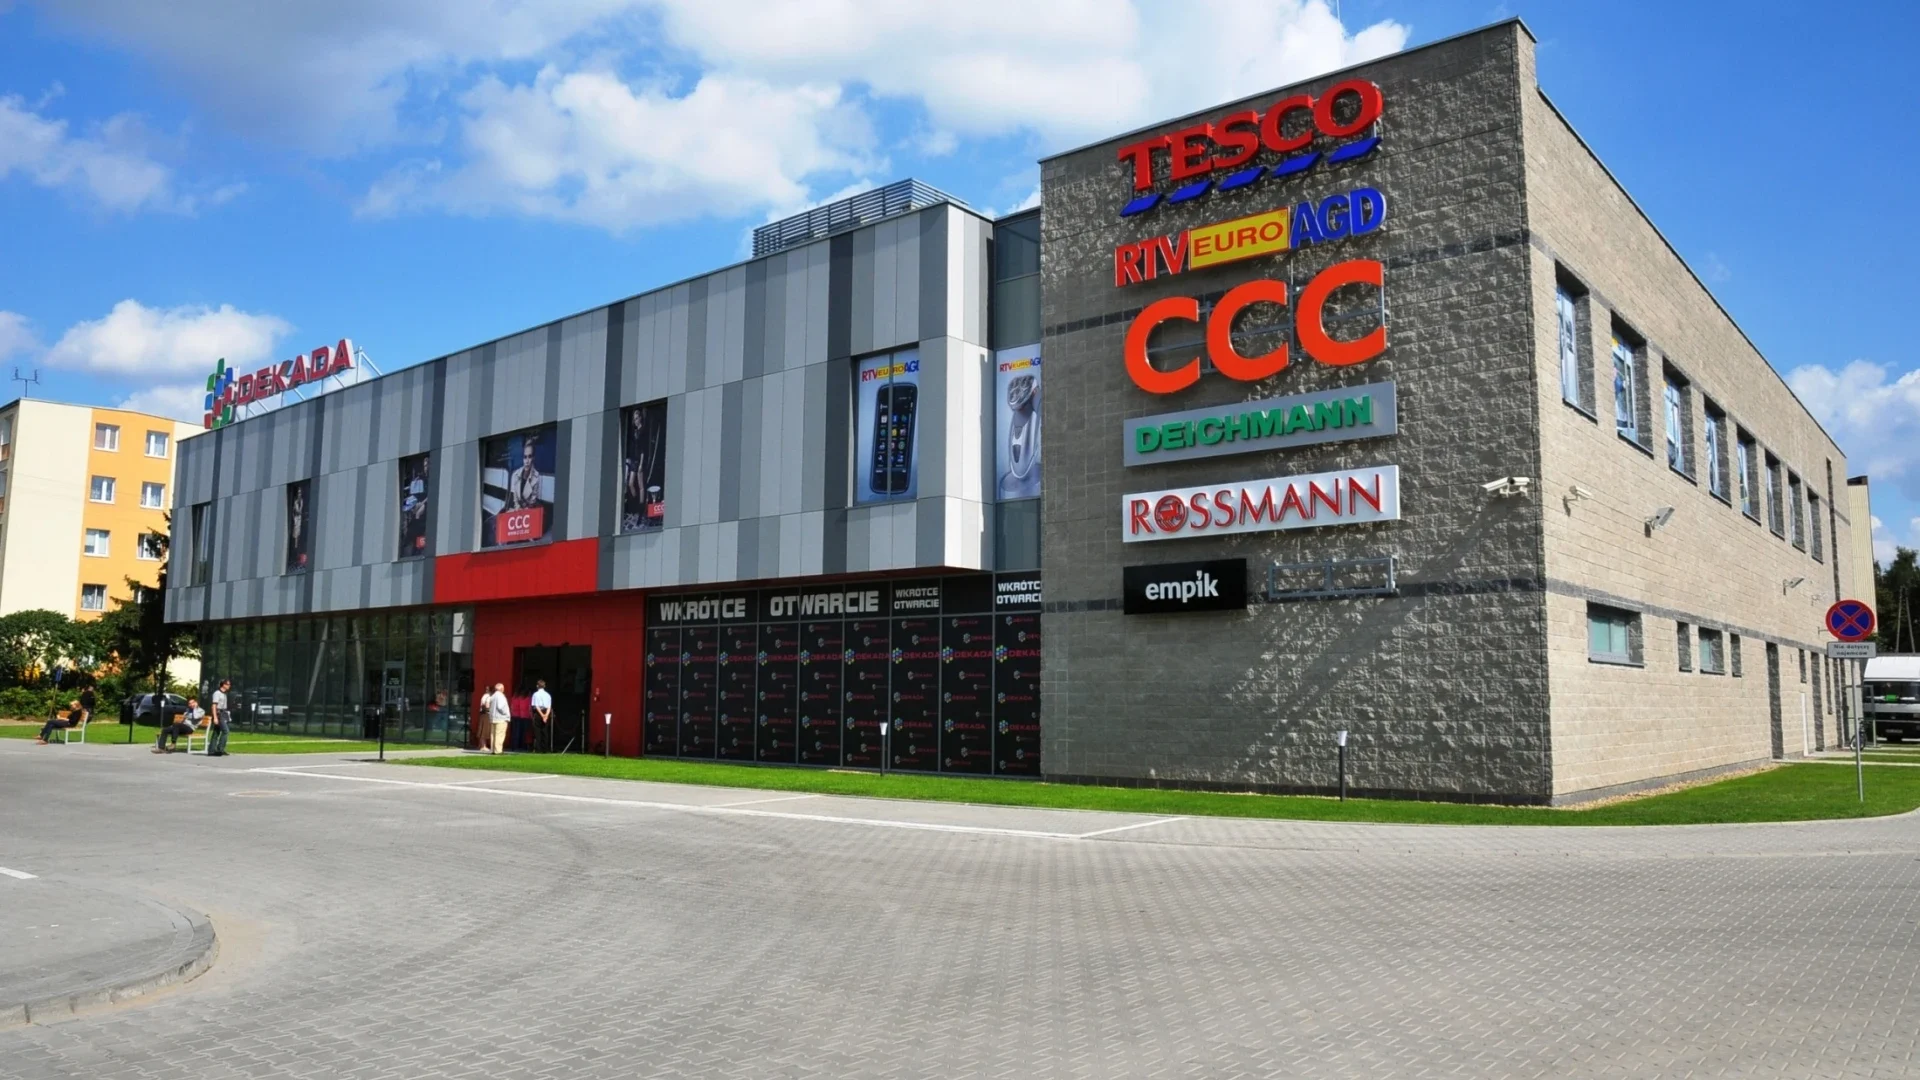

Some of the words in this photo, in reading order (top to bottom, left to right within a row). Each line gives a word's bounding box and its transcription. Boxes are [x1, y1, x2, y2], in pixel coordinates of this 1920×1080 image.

[1117, 77, 1383, 192] TESCO
[1114, 229, 1190, 288] RTV
[1194, 222, 1284, 258] EURO
[1289, 187, 1386, 249] AGD
[1123, 259, 1388, 394] CCC
[236, 338, 355, 405] DEKADA
[1136, 395, 1374, 454] DEICHMANN
[507, 514, 530, 531] CCC
[1130, 474, 1384, 535] ROSSMANN
[660, 596, 746, 621] WKRÓTCE
[769, 591, 879, 616] OTWARCIE
[893, 599, 940, 610] OTWARCIE
[1145, 570, 1219, 603] empik
